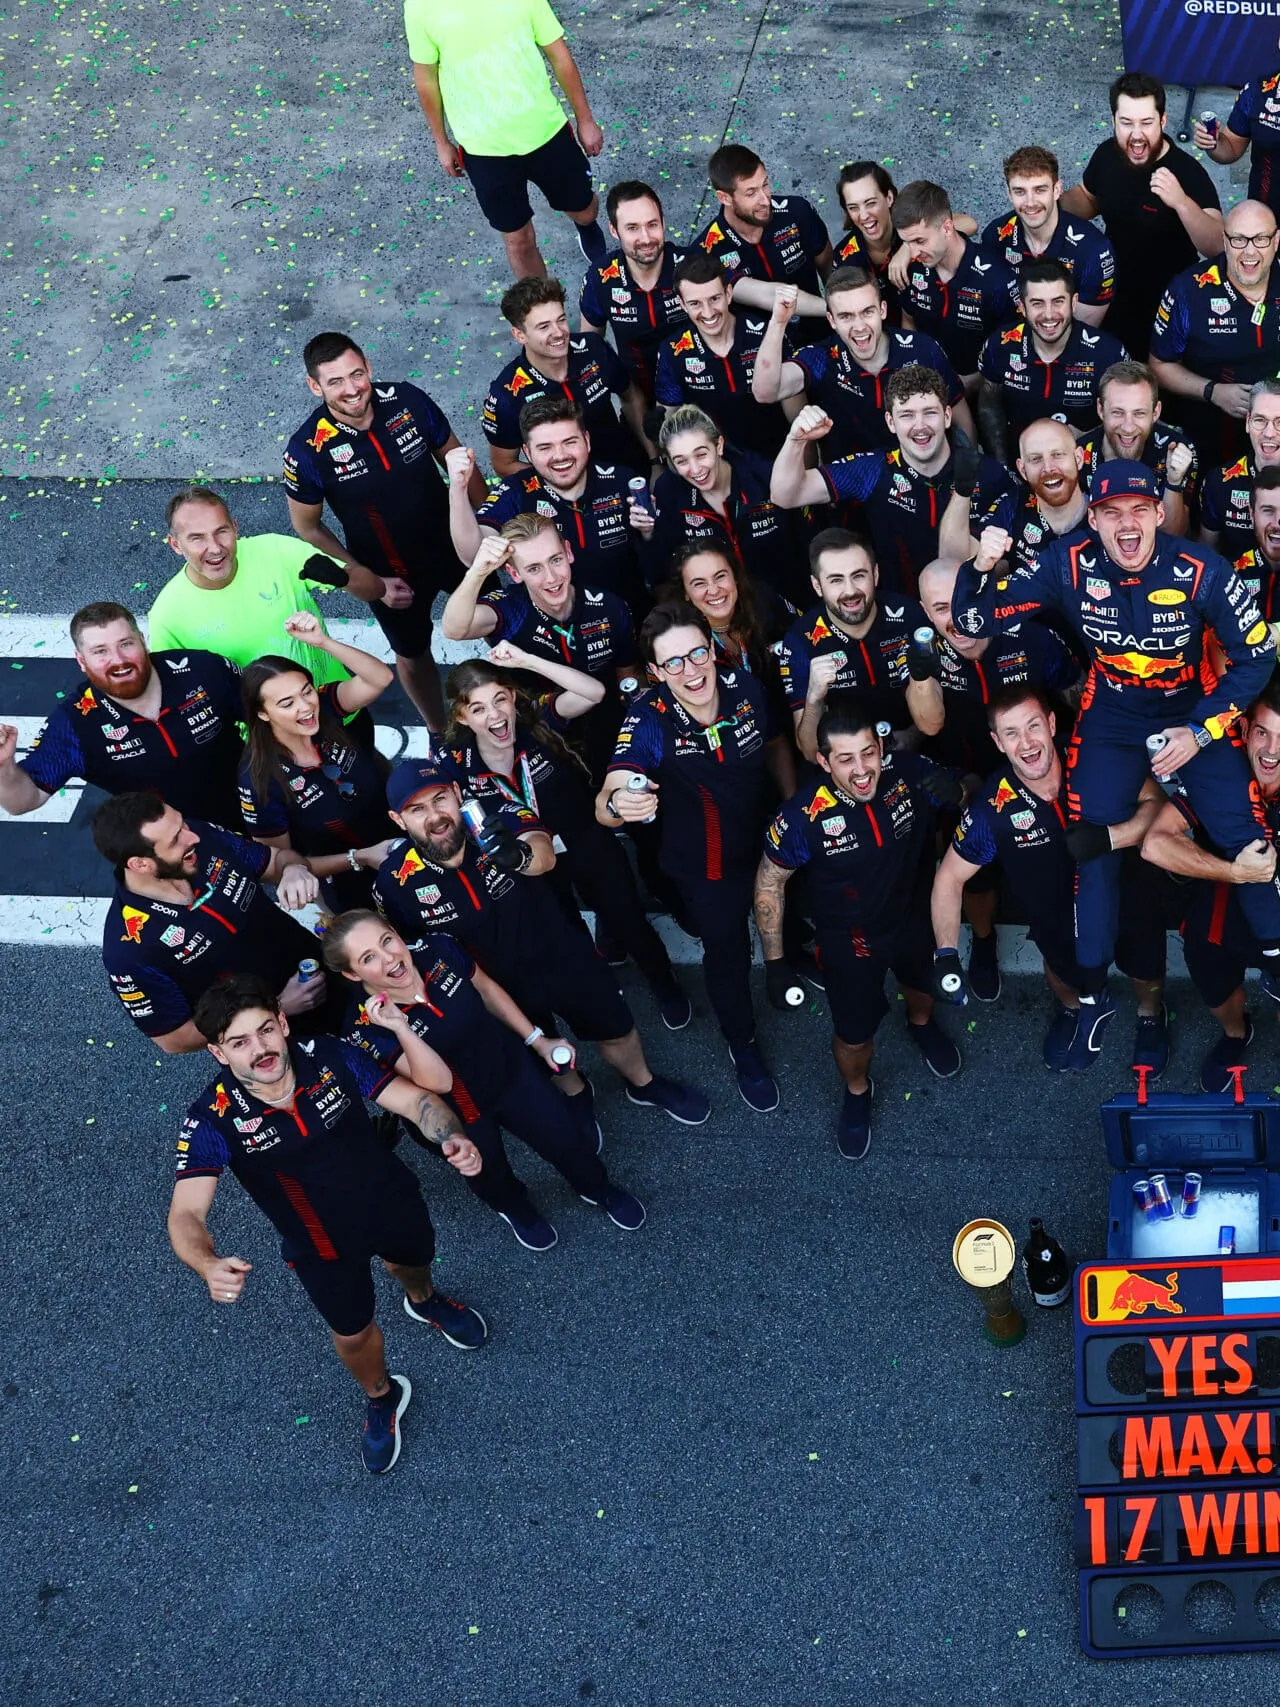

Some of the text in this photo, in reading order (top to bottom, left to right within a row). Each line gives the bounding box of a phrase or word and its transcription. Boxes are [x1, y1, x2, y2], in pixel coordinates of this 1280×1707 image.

[725, 228, 741, 247] zoom
[781, 241, 801, 258] BYBIT
[619, 265, 627, 286] zoom
[1224, 281, 1237, 302] zoom
[611, 306, 629, 314] Mobil
[959, 304, 979, 313] BYBIT
[693, 333, 705, 354] zoom
[841, 351, 851, 372] zoom
[528, 367, 548, 386] zoom
[685, 375, 704, 384] Mobil
[1004, 372, 1021, 382] Mobil
[1066, 380, 1091, 389] BYBIT
[585, 378, 603, 397] BYBIT
[1004, 381, 1029, 391] ORACLE
[588, 387, 609, 403] HONDA
[334, 421, 358, 436] zoom
[396, 426, 418, 446] BYBIT
[399, 437, 422, 453] HONDA
[334, 462, 356, 474] Mobil
[338, 468, 369, 482] ORACLE
[543, 485, 561, 501] zoom
[598, 513, 623, 528] BYBIT
[752, 517, 775, 530] BYBIT
[598, 525, 626, 536] HONDA
[1081, 602, 1107, 616] Mobil
[1153, 610, 1185, 623] BYBIT
[829, 625, 849, 644] zoom
[1152, 625, 1190, 633] HONDA
[587, 638, 610, 652] BYBIT
[1082, 625, 1191, 651] ORACLE
[588, 649, 613, 660] HONDA
[942, 640, 958, 660] zoom
[996, 651, 1025, 662] ORACLE
[1003, 672, 1028, 685] BYBIT
[101, 698, 121, 720] zoom
[187, 705, 214, 726] BYBIT
[672, 703, 690, 725] zoom
[190, 716, 219, 735] HONDA
[734, 720, 755, 739] BYBIT
[737, 729, 759, 747] HONDA
[106, 741, 132, 753] Mobil
[111, 748, 146, 761] ORACLE
[676, 747, 704, 755] ORACLE
[301, 790, 324, 809] ORACLE
[834, 789, 856, 808] zoom
[1019, 788, 1038, 809] zoom
[823, 836, 847, 848] Mobil
[1014, 831, 1037, 843] Mobil
[1017, 837, 1050, 849] ORACLE
[826, 843, 859, 856] ORACLE
[222, 869, 240, 897] BYBIT
[232, 876, 247, 904] HONDA
[151, 902, 178, 918] zoom
[421, 905, 444, 919] Mobil
[426, 912, 459, 926] ORACLE
[174, 939, 198, 961] Mobil
[182, 939, 212, 964] ORACLE
[441, 972, 457, 991] BYBIT
[448, 978, 463, 998] HONDA
[232, 1087, 250, 1114] zoom
[316, 1086, 342, 1110] BYBIT
[243, 1131, 267, 1147] Mobil
[1148, 1333, 1253, 1398] YES
[1122, 1412, 1274, 1479] MAX!
[1084, 1497, 1157, 1565] 17
